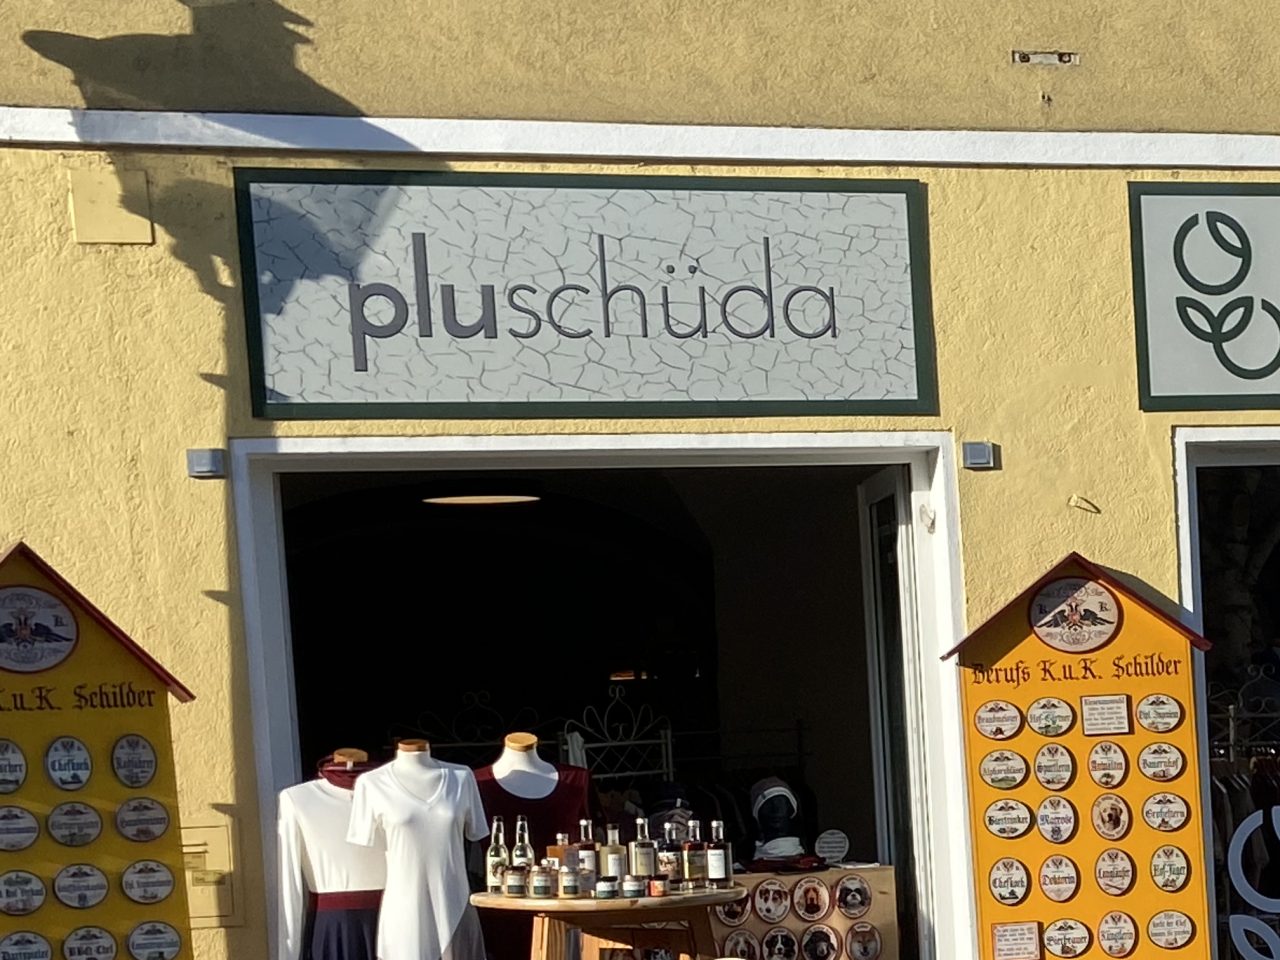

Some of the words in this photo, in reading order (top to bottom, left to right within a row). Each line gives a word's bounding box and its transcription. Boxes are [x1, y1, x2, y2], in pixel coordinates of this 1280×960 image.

[348, 231, 838, 373] pluschüda
[971, 660, 1031, 690] Berufs
[1111, 651, 1183, 680] Schilder
[72, 682, 156, 710] Schilder
